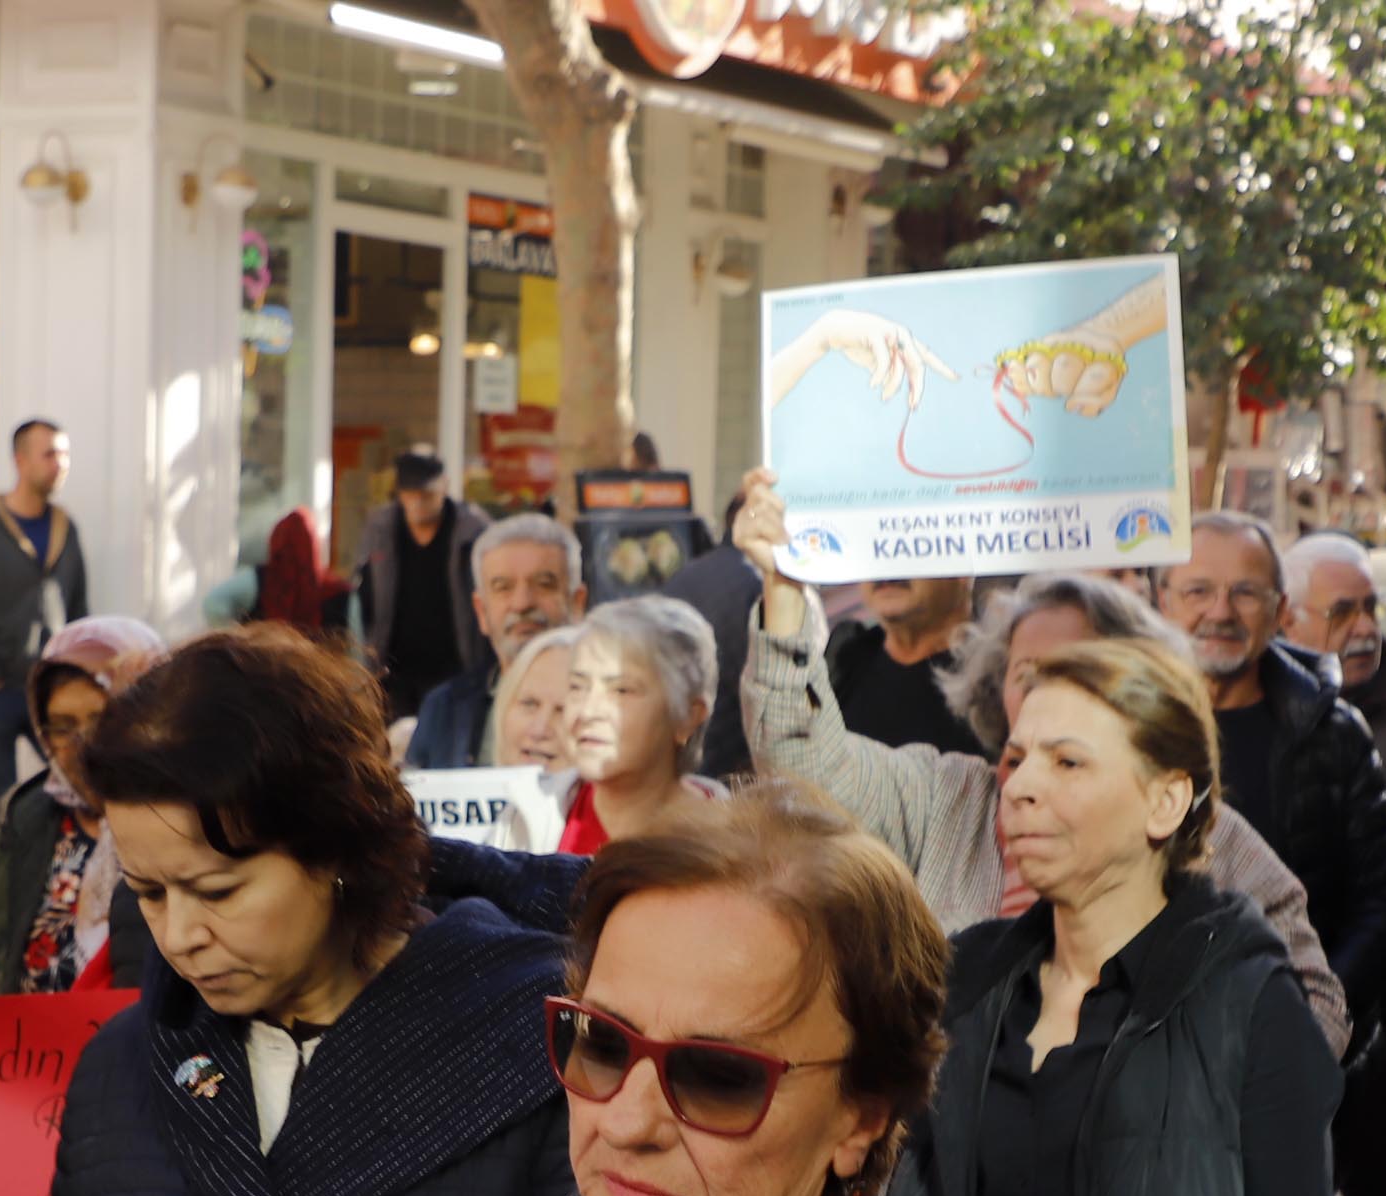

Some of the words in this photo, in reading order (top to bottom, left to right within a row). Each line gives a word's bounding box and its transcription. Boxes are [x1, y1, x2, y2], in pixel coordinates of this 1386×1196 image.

[878, 514, 939, 533] KEŞAN
[946, 511, 993, 527] KENT
[1000, 504, 1081, 525] KONSEYİ
[873, 532, 966, 560] KADIN
[976, 522, 1092, 553] MECLİSİ
